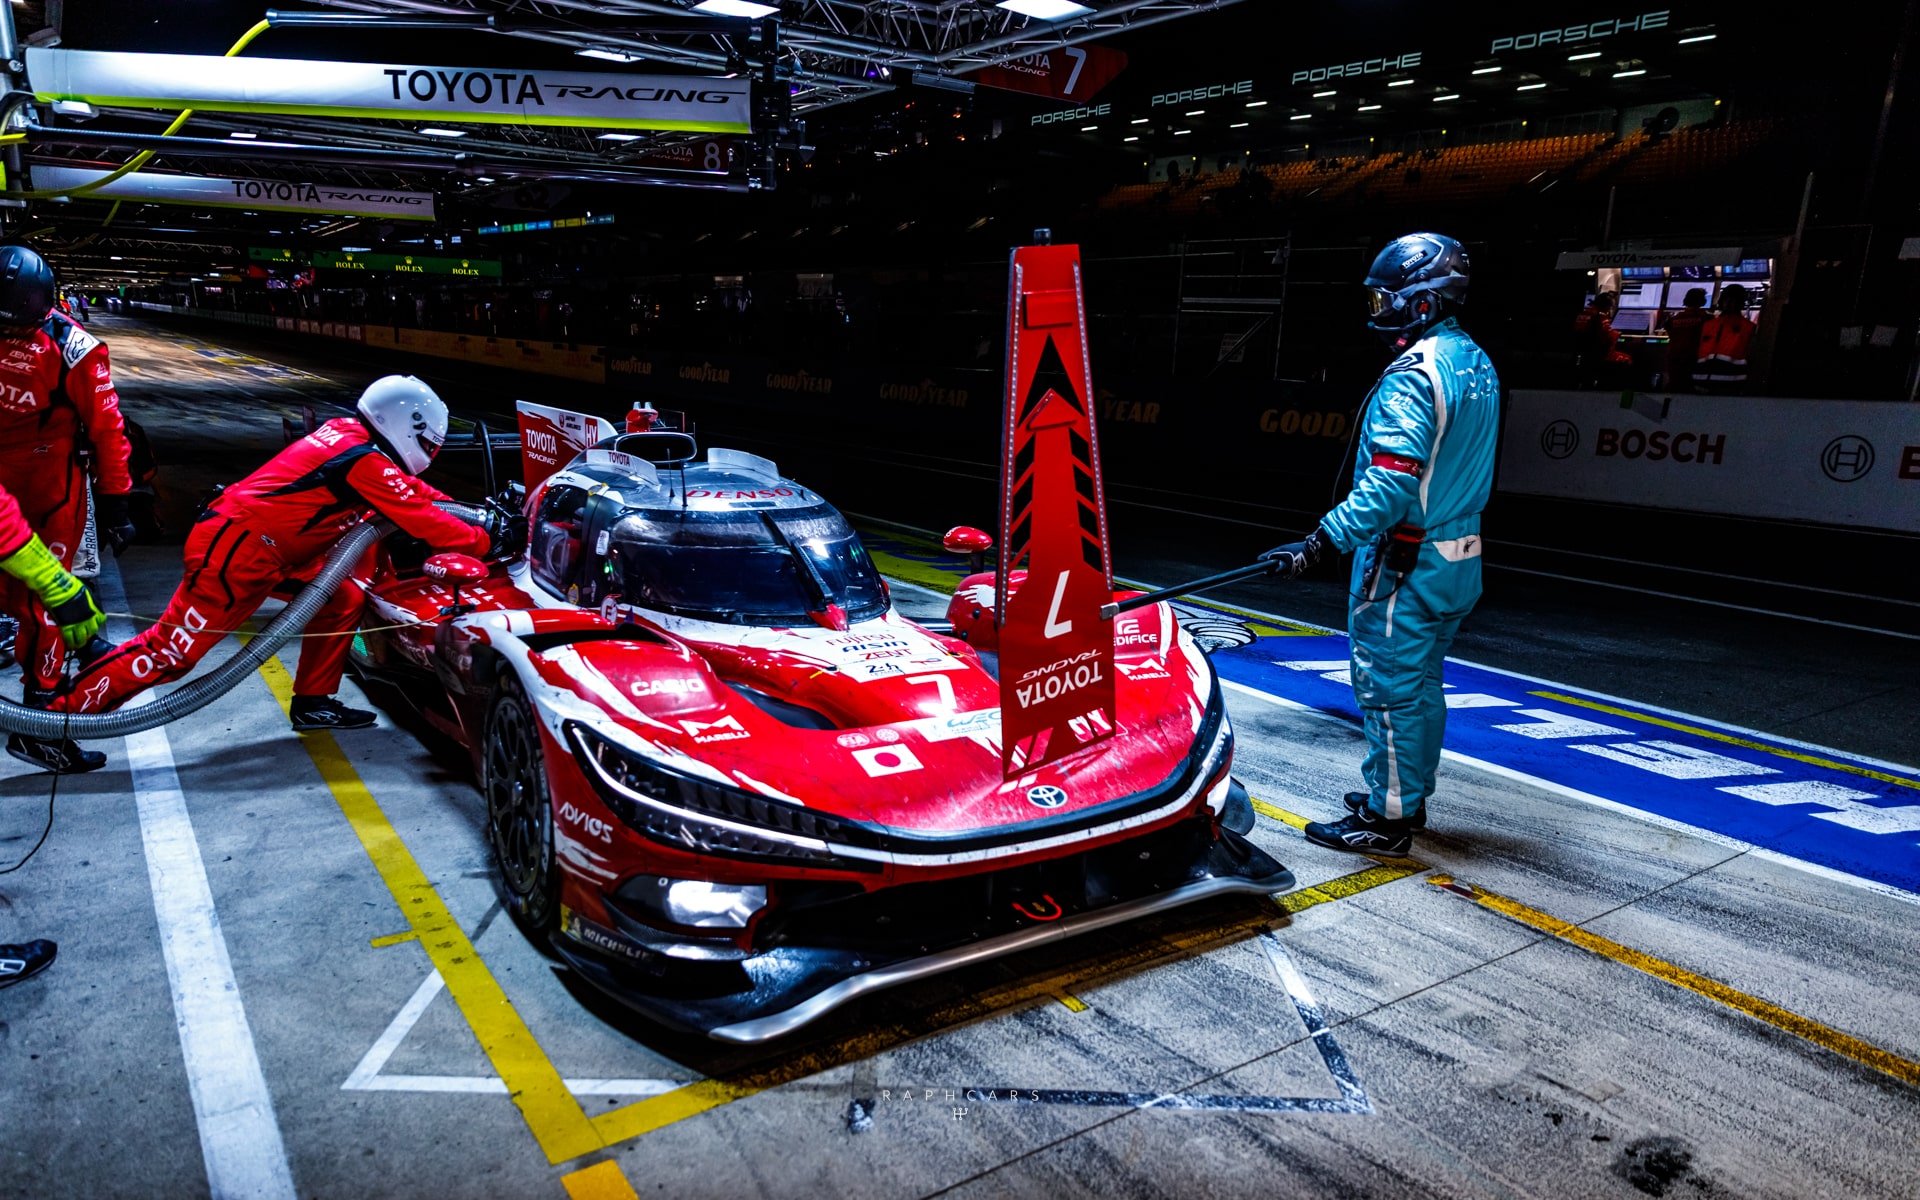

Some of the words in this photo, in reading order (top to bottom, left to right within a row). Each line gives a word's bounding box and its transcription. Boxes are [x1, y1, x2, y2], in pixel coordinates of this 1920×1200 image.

[1491, 10, 1670, 54] PORSCHE
[1064, 46, 1087, 95] 7
[1292, 52, 1423, 86] PORSCHE
[384, 69, 545, 106] TOYOTA
[544, 84, 746, 104] RACING
[1151, 80, 1253, 107] PORSCHE
[1031, 103, 1112, 128] PORSCHE
[704, 142, 720, 171] 8
[232, 180, 321, 202] TOYOTA
[319, 190, 428, 205] RACING
[336, 260, 365, 270] ROLEX
[395, 263, 424, 273] ROLEX
[1590, 253, 1637, 264] TOYOTA
[452, 267, 480, 276] ROLEX
[766, 370, 833, 394] GOODYEAR
[880, 381, 970, 409] GOODYEAR
[525, 428, 558, 454] TOYOTA
[586, 423, 598, 448] HY
[1595, 427, 1726, 465] BOSCH
[526, 450, 559, 465] RACING
[608, 451, 631, 467] TOYOTA
[686, 487, 794, 500] DENSO
[1044, 569, 1073, 639] 7
[132, 606, 209, 679] DENSO
[825, 634, 896, 646] FUJITSU
[859, 649, 913, 660] ZENT
[1016, 648, 1102, 685] RACING
[630, 678, 705, 697] CASIO
[1016, 661, 1103, 709] TOYOTA
[1128, 671, 1172, 681] MARELLI
[905, 673, 959, 714] 7
[694, 731, 752, 744] MARELLI
